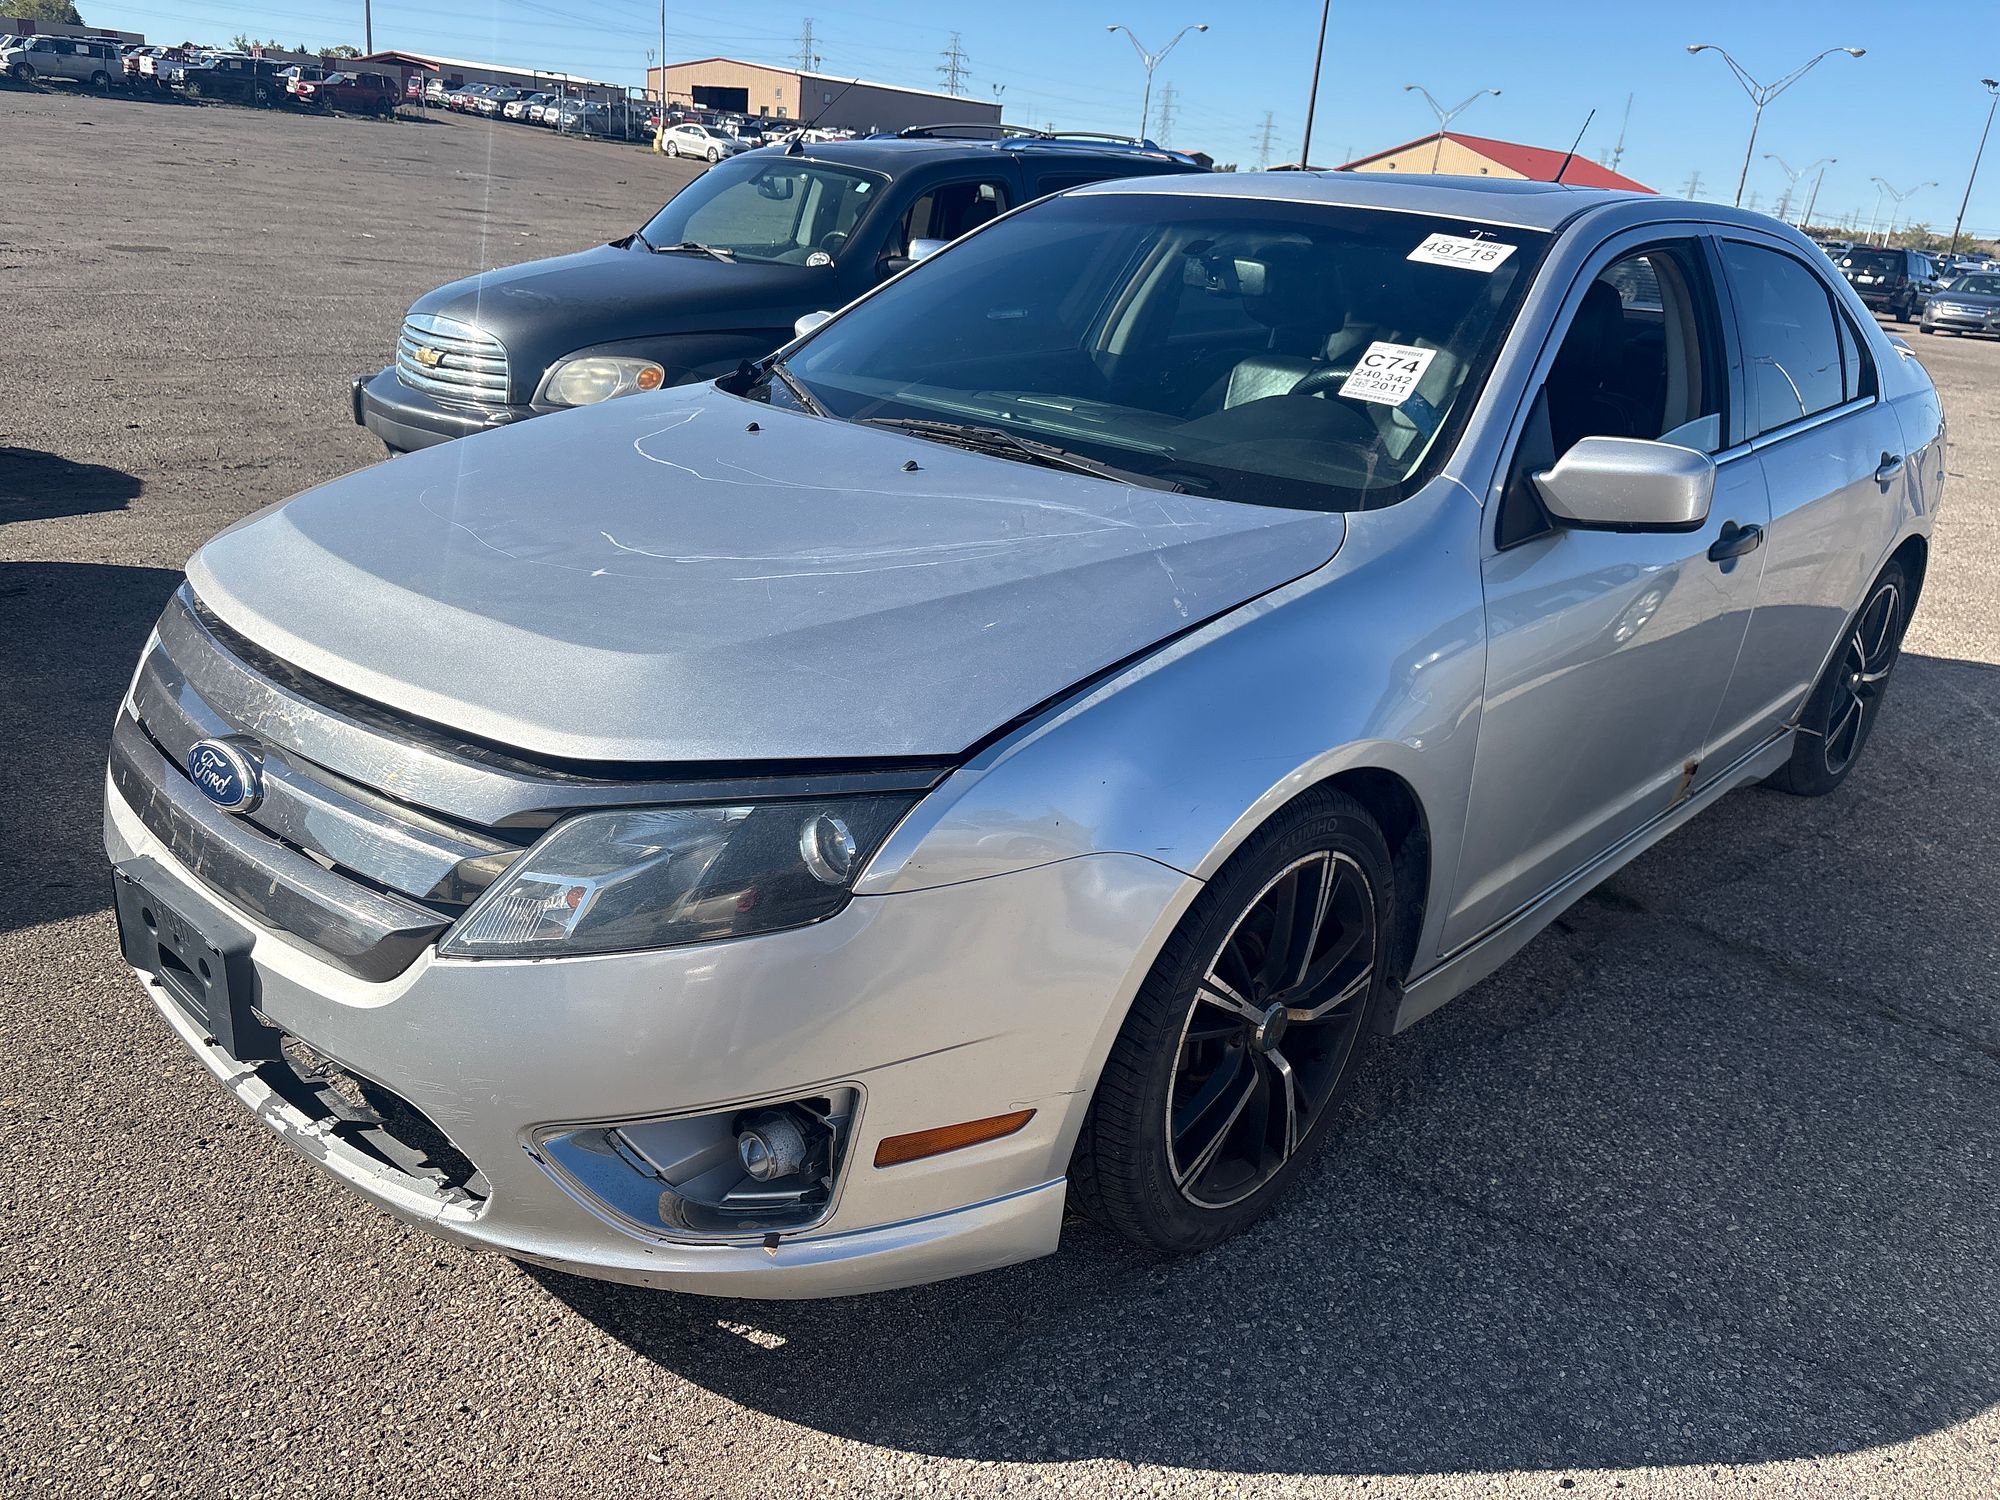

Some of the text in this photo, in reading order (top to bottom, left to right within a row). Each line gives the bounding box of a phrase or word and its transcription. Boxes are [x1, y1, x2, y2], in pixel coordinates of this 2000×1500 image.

[1422, 242, 1498, 261] 48718
[1364, 353, 1420, 374] C74
[1354, 368, 1413, 385] 240,342
[1370, 380, 1406, 394] 2011
[194, 750, 233, 796] Ford
[1279, 817, 1338, 855] KUMHO
